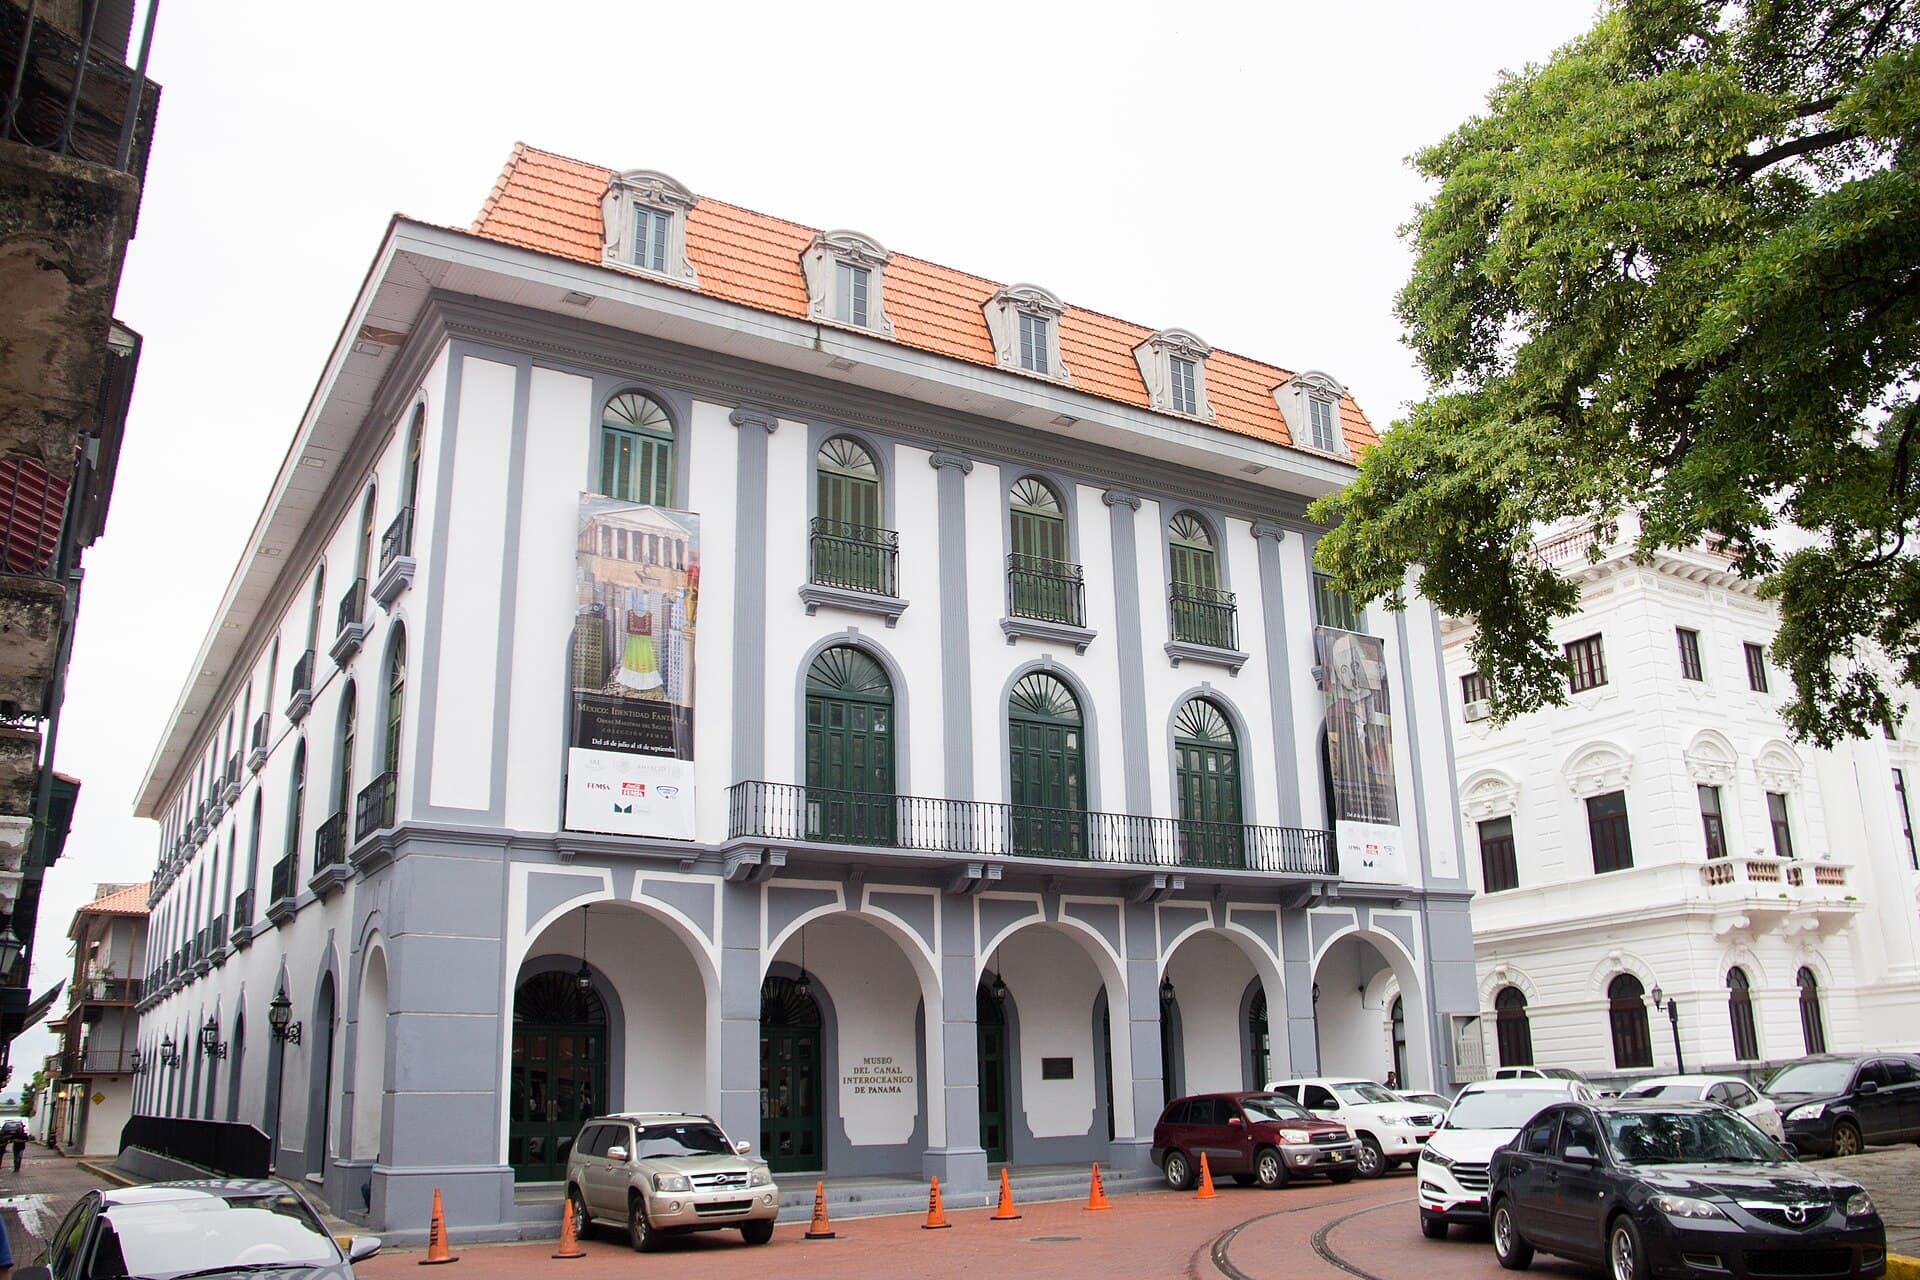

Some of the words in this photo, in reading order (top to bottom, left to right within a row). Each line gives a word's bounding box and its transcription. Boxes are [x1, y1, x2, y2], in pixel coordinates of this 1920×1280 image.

[617, 740, 630, 749] julio
[587, 782, 610, 791] FEMSA
[863, 1057, 893, 1065] MUSEO
[873, 1066, 903, 1074] CANAL
[842, 1076, 913, 1085] INTEROCEANICO
[854, 1086, 866, 1094] DE
[868, 1086, 902, 1094] PANAMA
